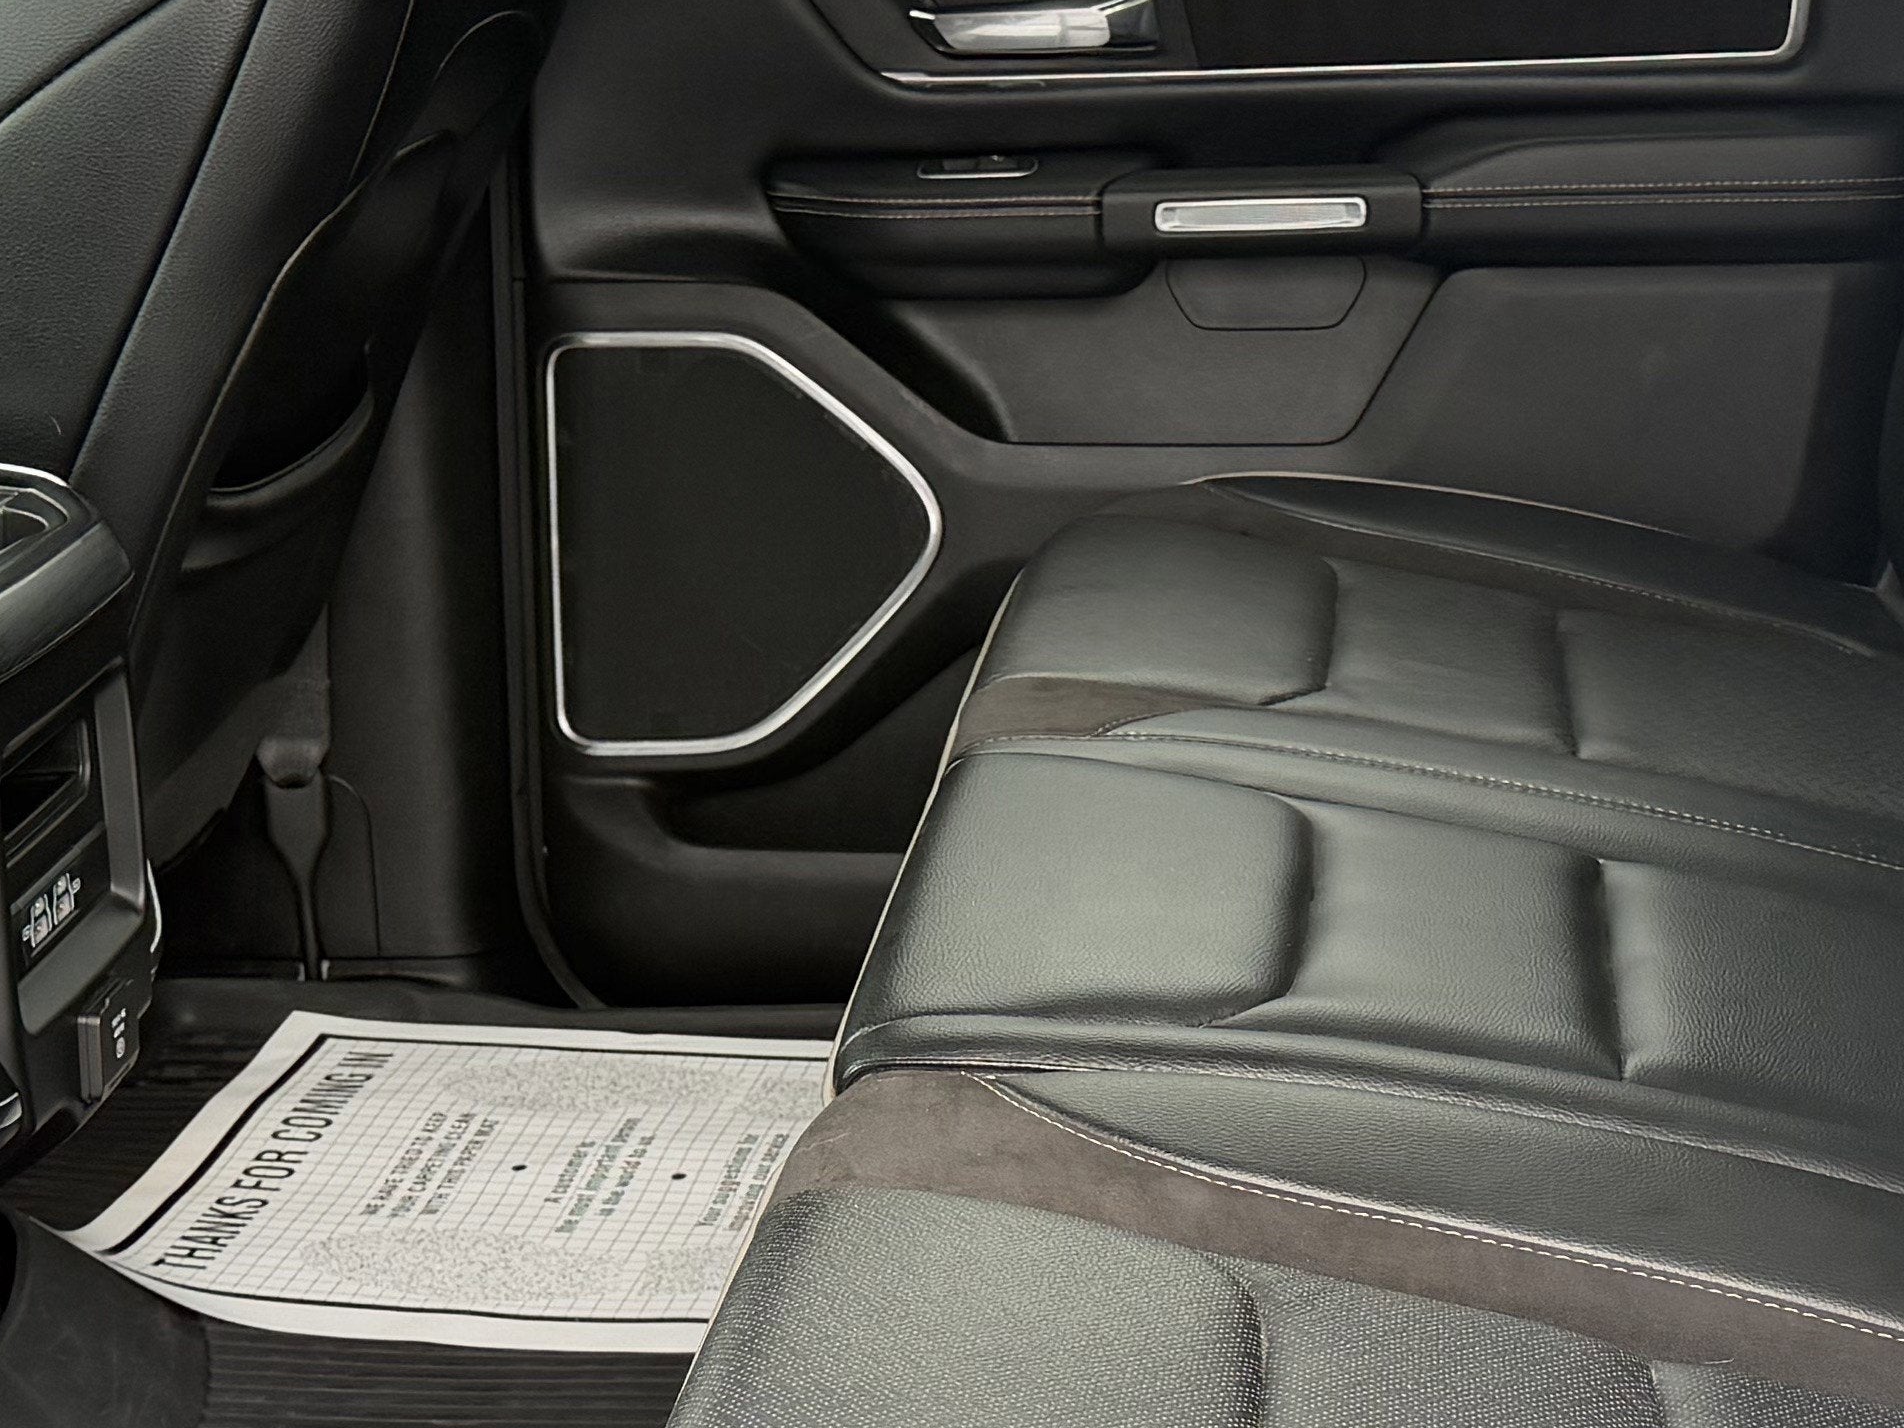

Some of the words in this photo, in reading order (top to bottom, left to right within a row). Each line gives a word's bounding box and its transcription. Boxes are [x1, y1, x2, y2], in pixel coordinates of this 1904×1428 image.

[152, 1196, 270, 1269] THANKS
[230, 1150, 309, 1191] FOR
[271, 1073, 374, 1142] COMING
[337, 1051, 394, 1068] IN
